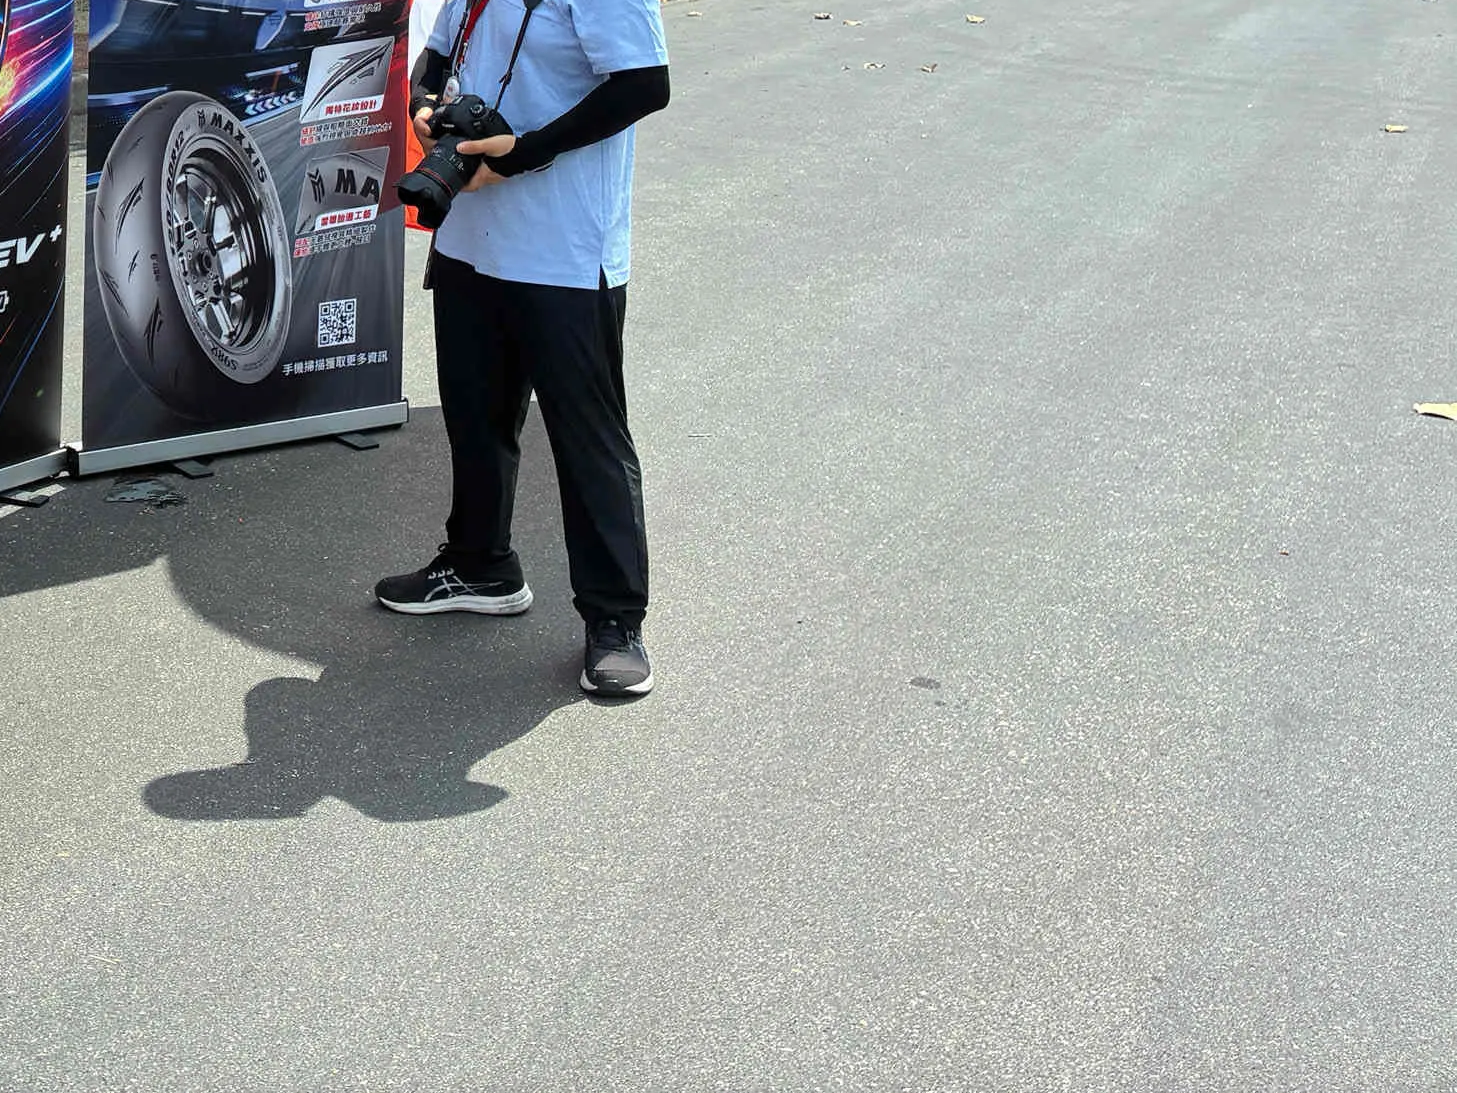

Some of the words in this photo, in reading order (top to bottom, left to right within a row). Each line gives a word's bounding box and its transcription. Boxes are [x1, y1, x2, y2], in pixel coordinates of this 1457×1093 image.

[210, 111, 267, 184] MAXXIS
[282, 350, 388, 376] 手機掃描獲取更多資訊
